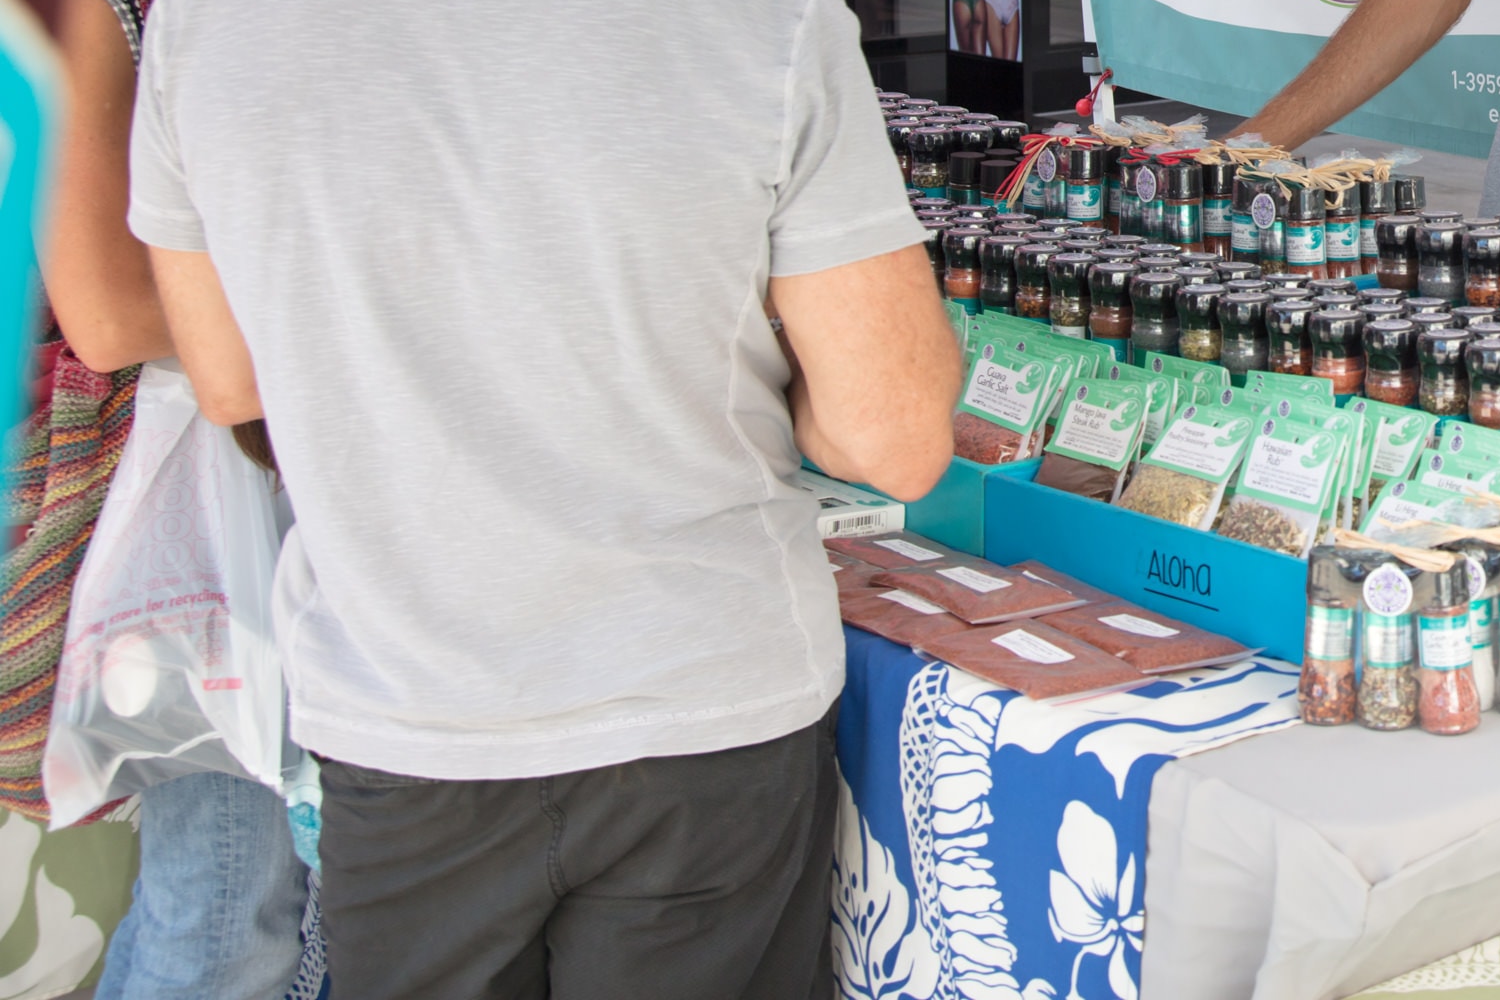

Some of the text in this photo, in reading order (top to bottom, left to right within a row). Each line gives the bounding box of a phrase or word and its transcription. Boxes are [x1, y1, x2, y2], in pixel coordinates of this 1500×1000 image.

[987, 366, 1007, 382] Guava
[977, 374, 1009, 395] Garlic Salt
[146, 599, 164, 614] for
